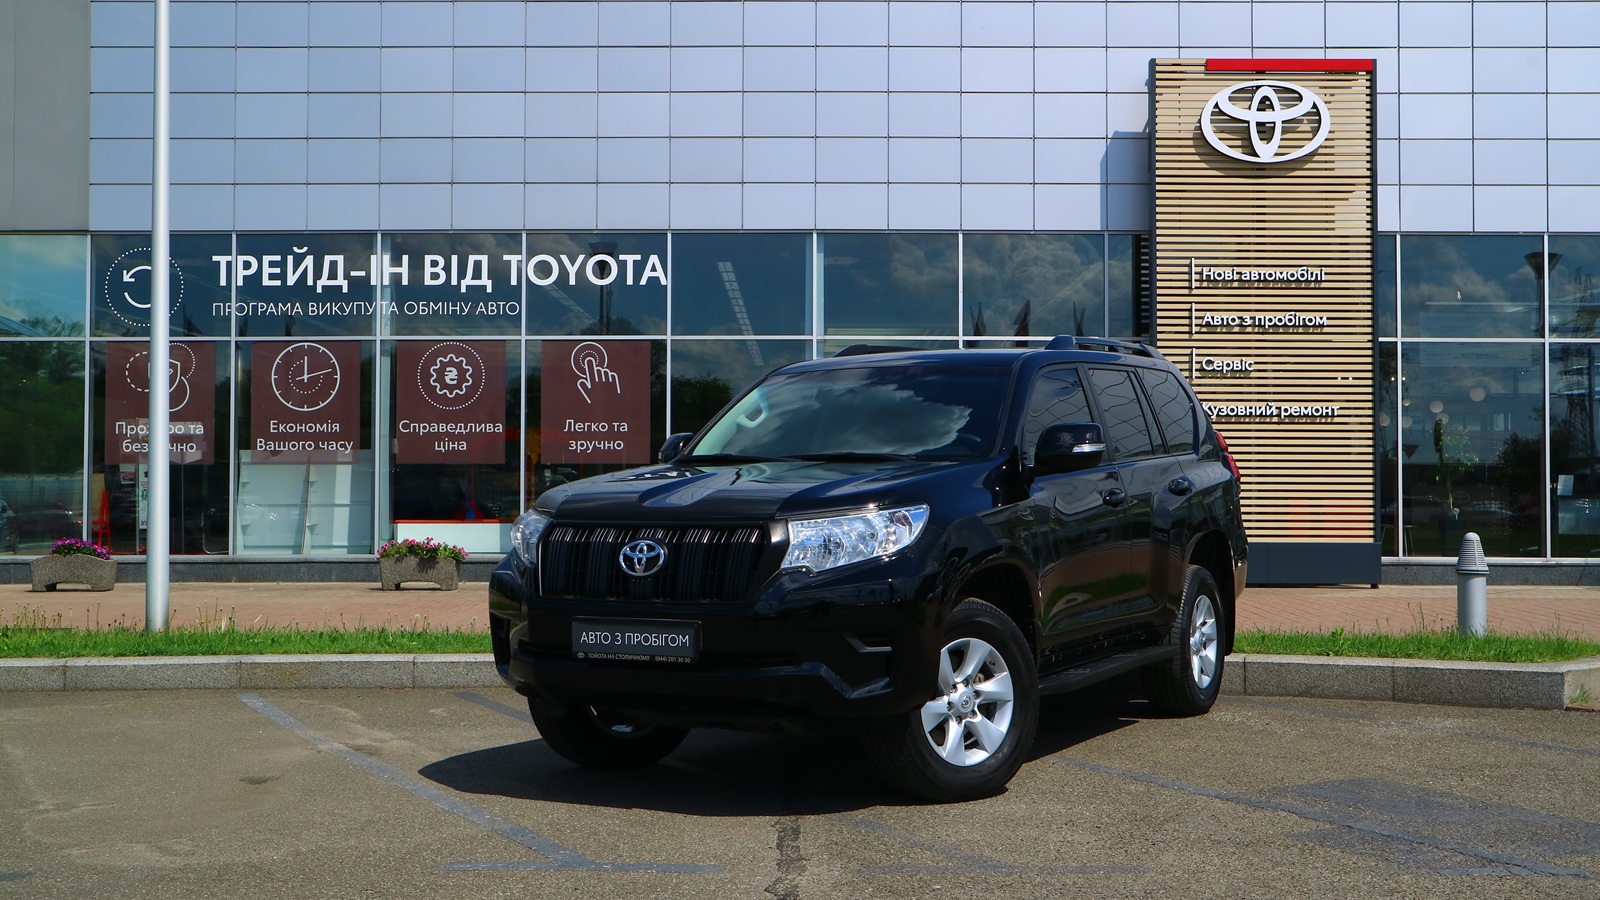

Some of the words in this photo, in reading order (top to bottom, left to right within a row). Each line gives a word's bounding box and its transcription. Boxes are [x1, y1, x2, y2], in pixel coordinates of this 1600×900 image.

[212, 247, 409, 293] ТРЕЙД-ІН
[424, 254, 492, 293] ВІД
[503, 254, 667, 286] TOYOTA
[1202, 267, 1237, 281] Нові
[1241, 267, 1326, 281] автомобілі
[212, 302, 303, 316] ПРОГРАМА
[308, 301, 376, 316] ВИКУПУ
[380, 301, 399, 315] ТА
[404, 301, 472, 316] ОБМІНУ
[475, 301, 520, 316] АВТО
[1202, 312, 1238, 326] Авто
[1242, 315, 1251, 326] з
[1255, 312, 1328, 329] пробігом
[1202, 357, 1255, 374] Сервіс
[1201, 402, 1276, 419] Кузовний
[1281, 405, 1340, 419] ремонт
[188, 424, 204, 434] та
[269, 420, 340, 433] Економія
[399, 420, 503, 434] Справедлива
[563, 419, 608, 432] Легко
[612, 422, 628, 432] та
[256, 438, 316, 451] Вашого
[319, 441, 354, 453] часу
[434, 438, 467, 452] ціна
[568, 440, 624, 454] зручно
[580, 631, 611, 644] АВТО
[625, 633, 689, 647] ПРОБІГОМ
